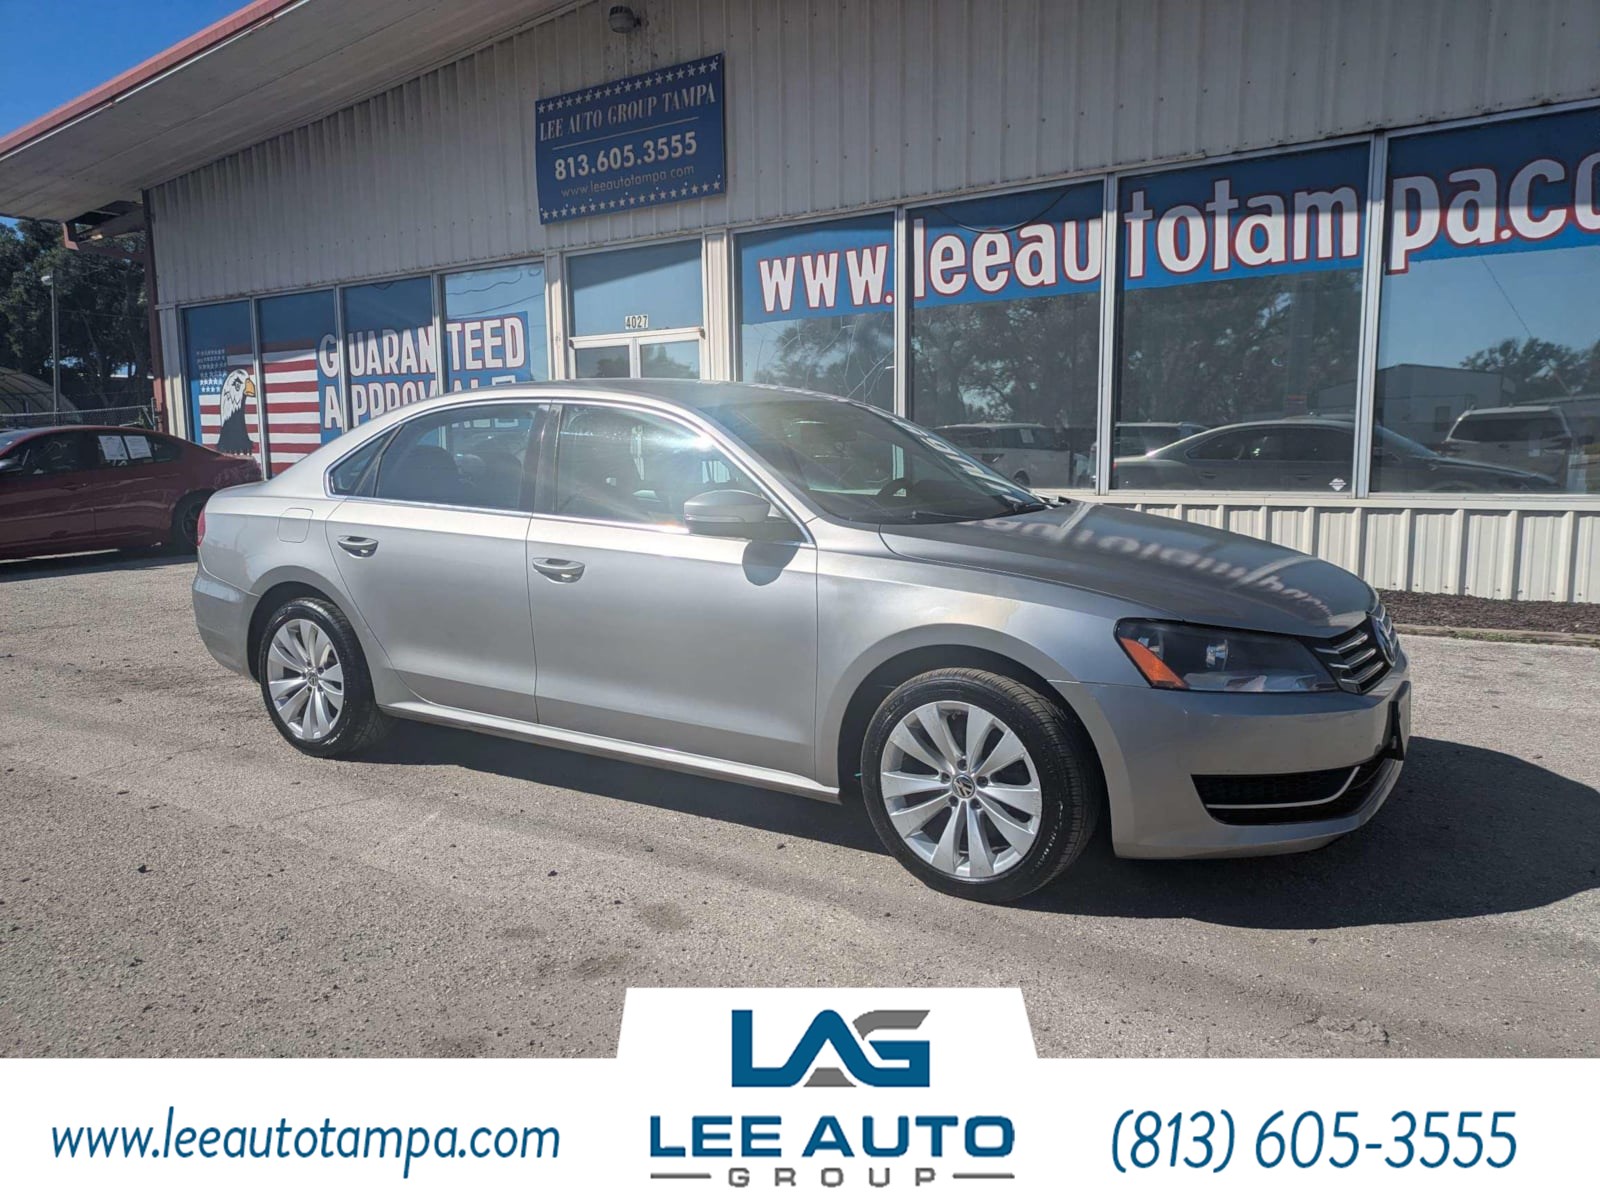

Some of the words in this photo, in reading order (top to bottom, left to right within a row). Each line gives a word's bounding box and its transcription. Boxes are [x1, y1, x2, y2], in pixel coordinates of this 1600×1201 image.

[540, 118, 563, 141] LEE
[568, 109, 602, 135] AUTO
[608, 96, 657, 125] GROUP
[662, 82, 716, 113] TAMPA
[555, 131, 698, 181] 813.605.3555
[561, 165, 695, 197] www.leeautotampacom
[319, 316, 526, 378] GUARANTEED
[626, 315, 648, 329] 4027
